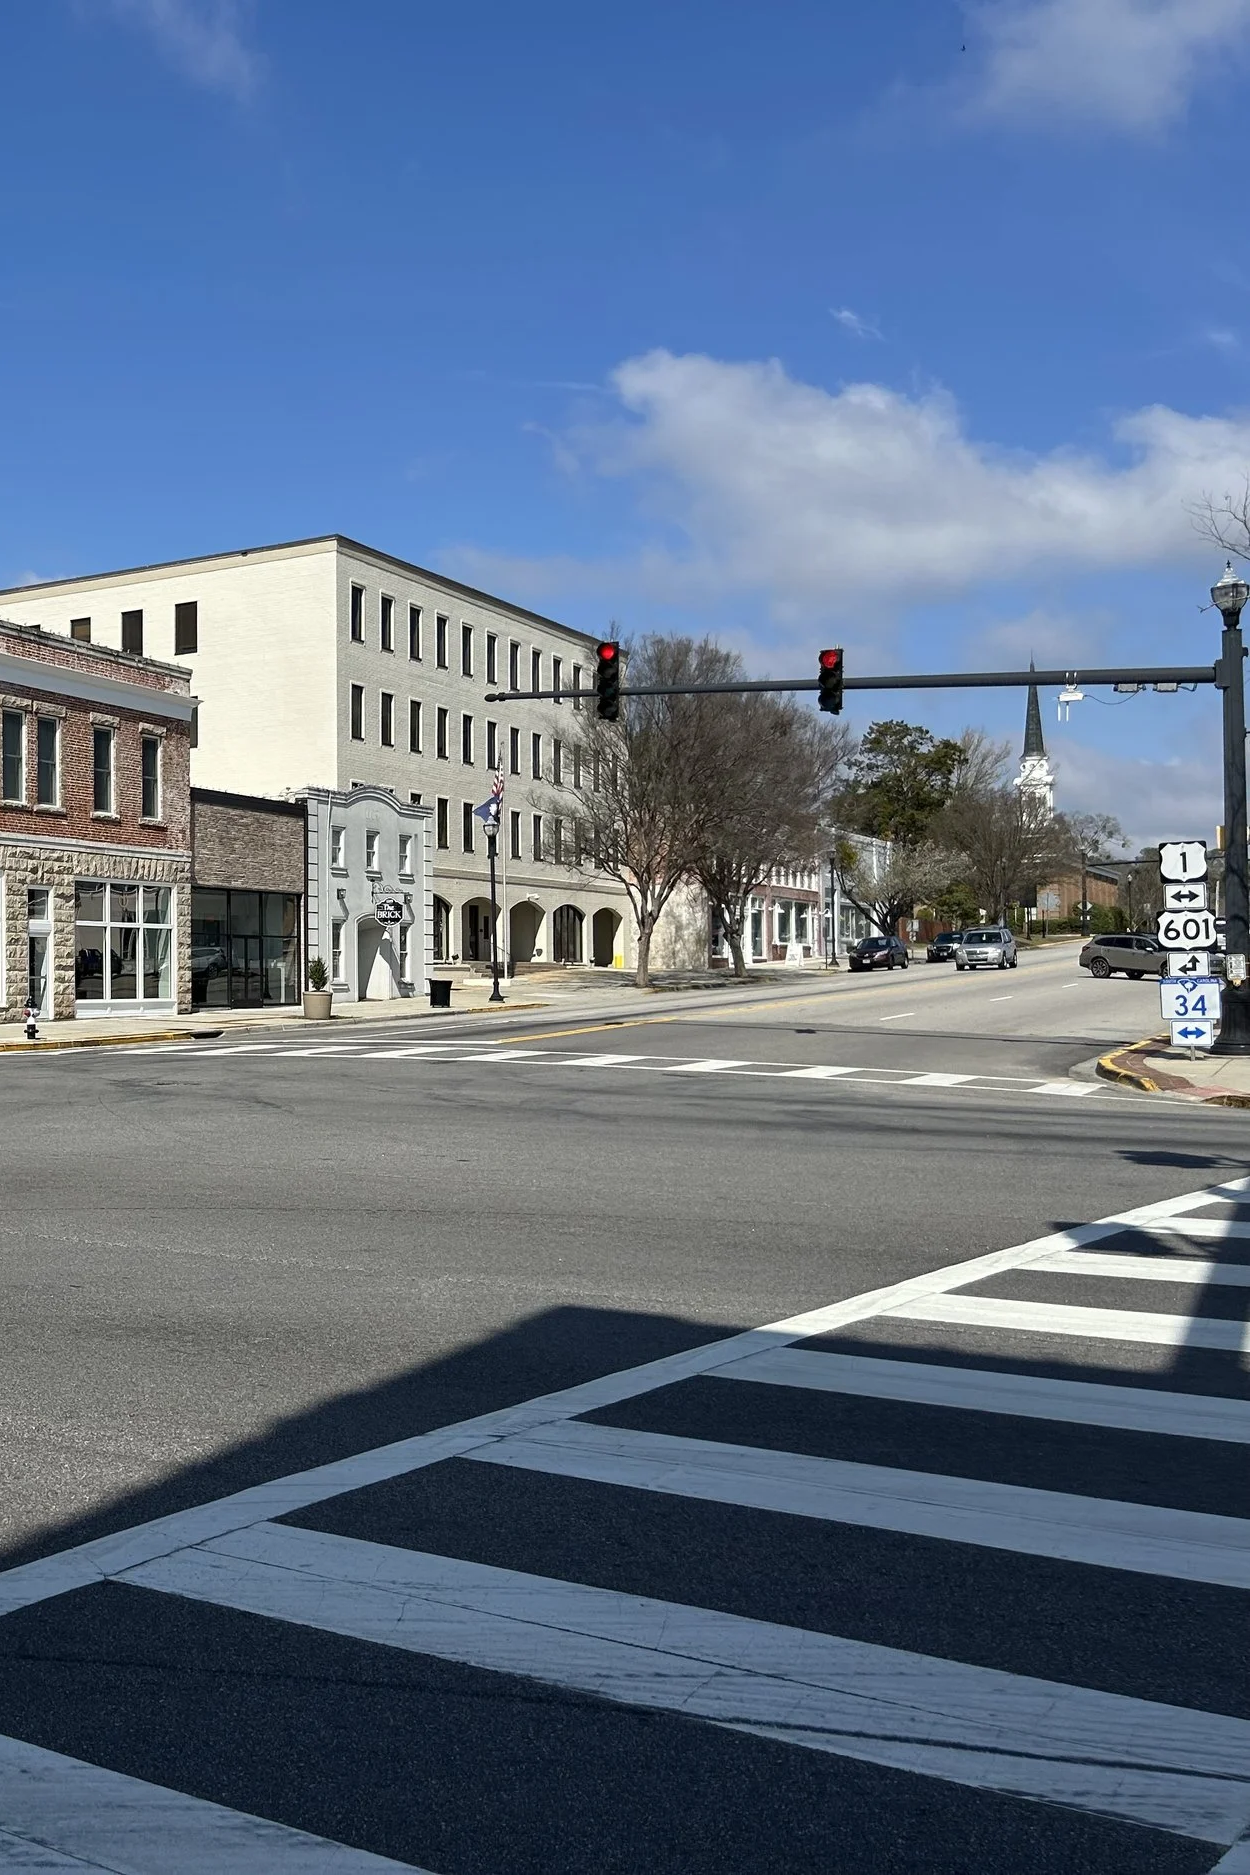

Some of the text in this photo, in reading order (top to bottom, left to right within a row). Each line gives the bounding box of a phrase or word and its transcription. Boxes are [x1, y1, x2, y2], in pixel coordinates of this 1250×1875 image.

[1179, 851, 1188, 873] 1
[377, 910, 402, 919] BRICK
[382, 903, 395, 911] The
[1163, 918, 1210, 941] 601
[1174, 994, 1208, 1017] 34
